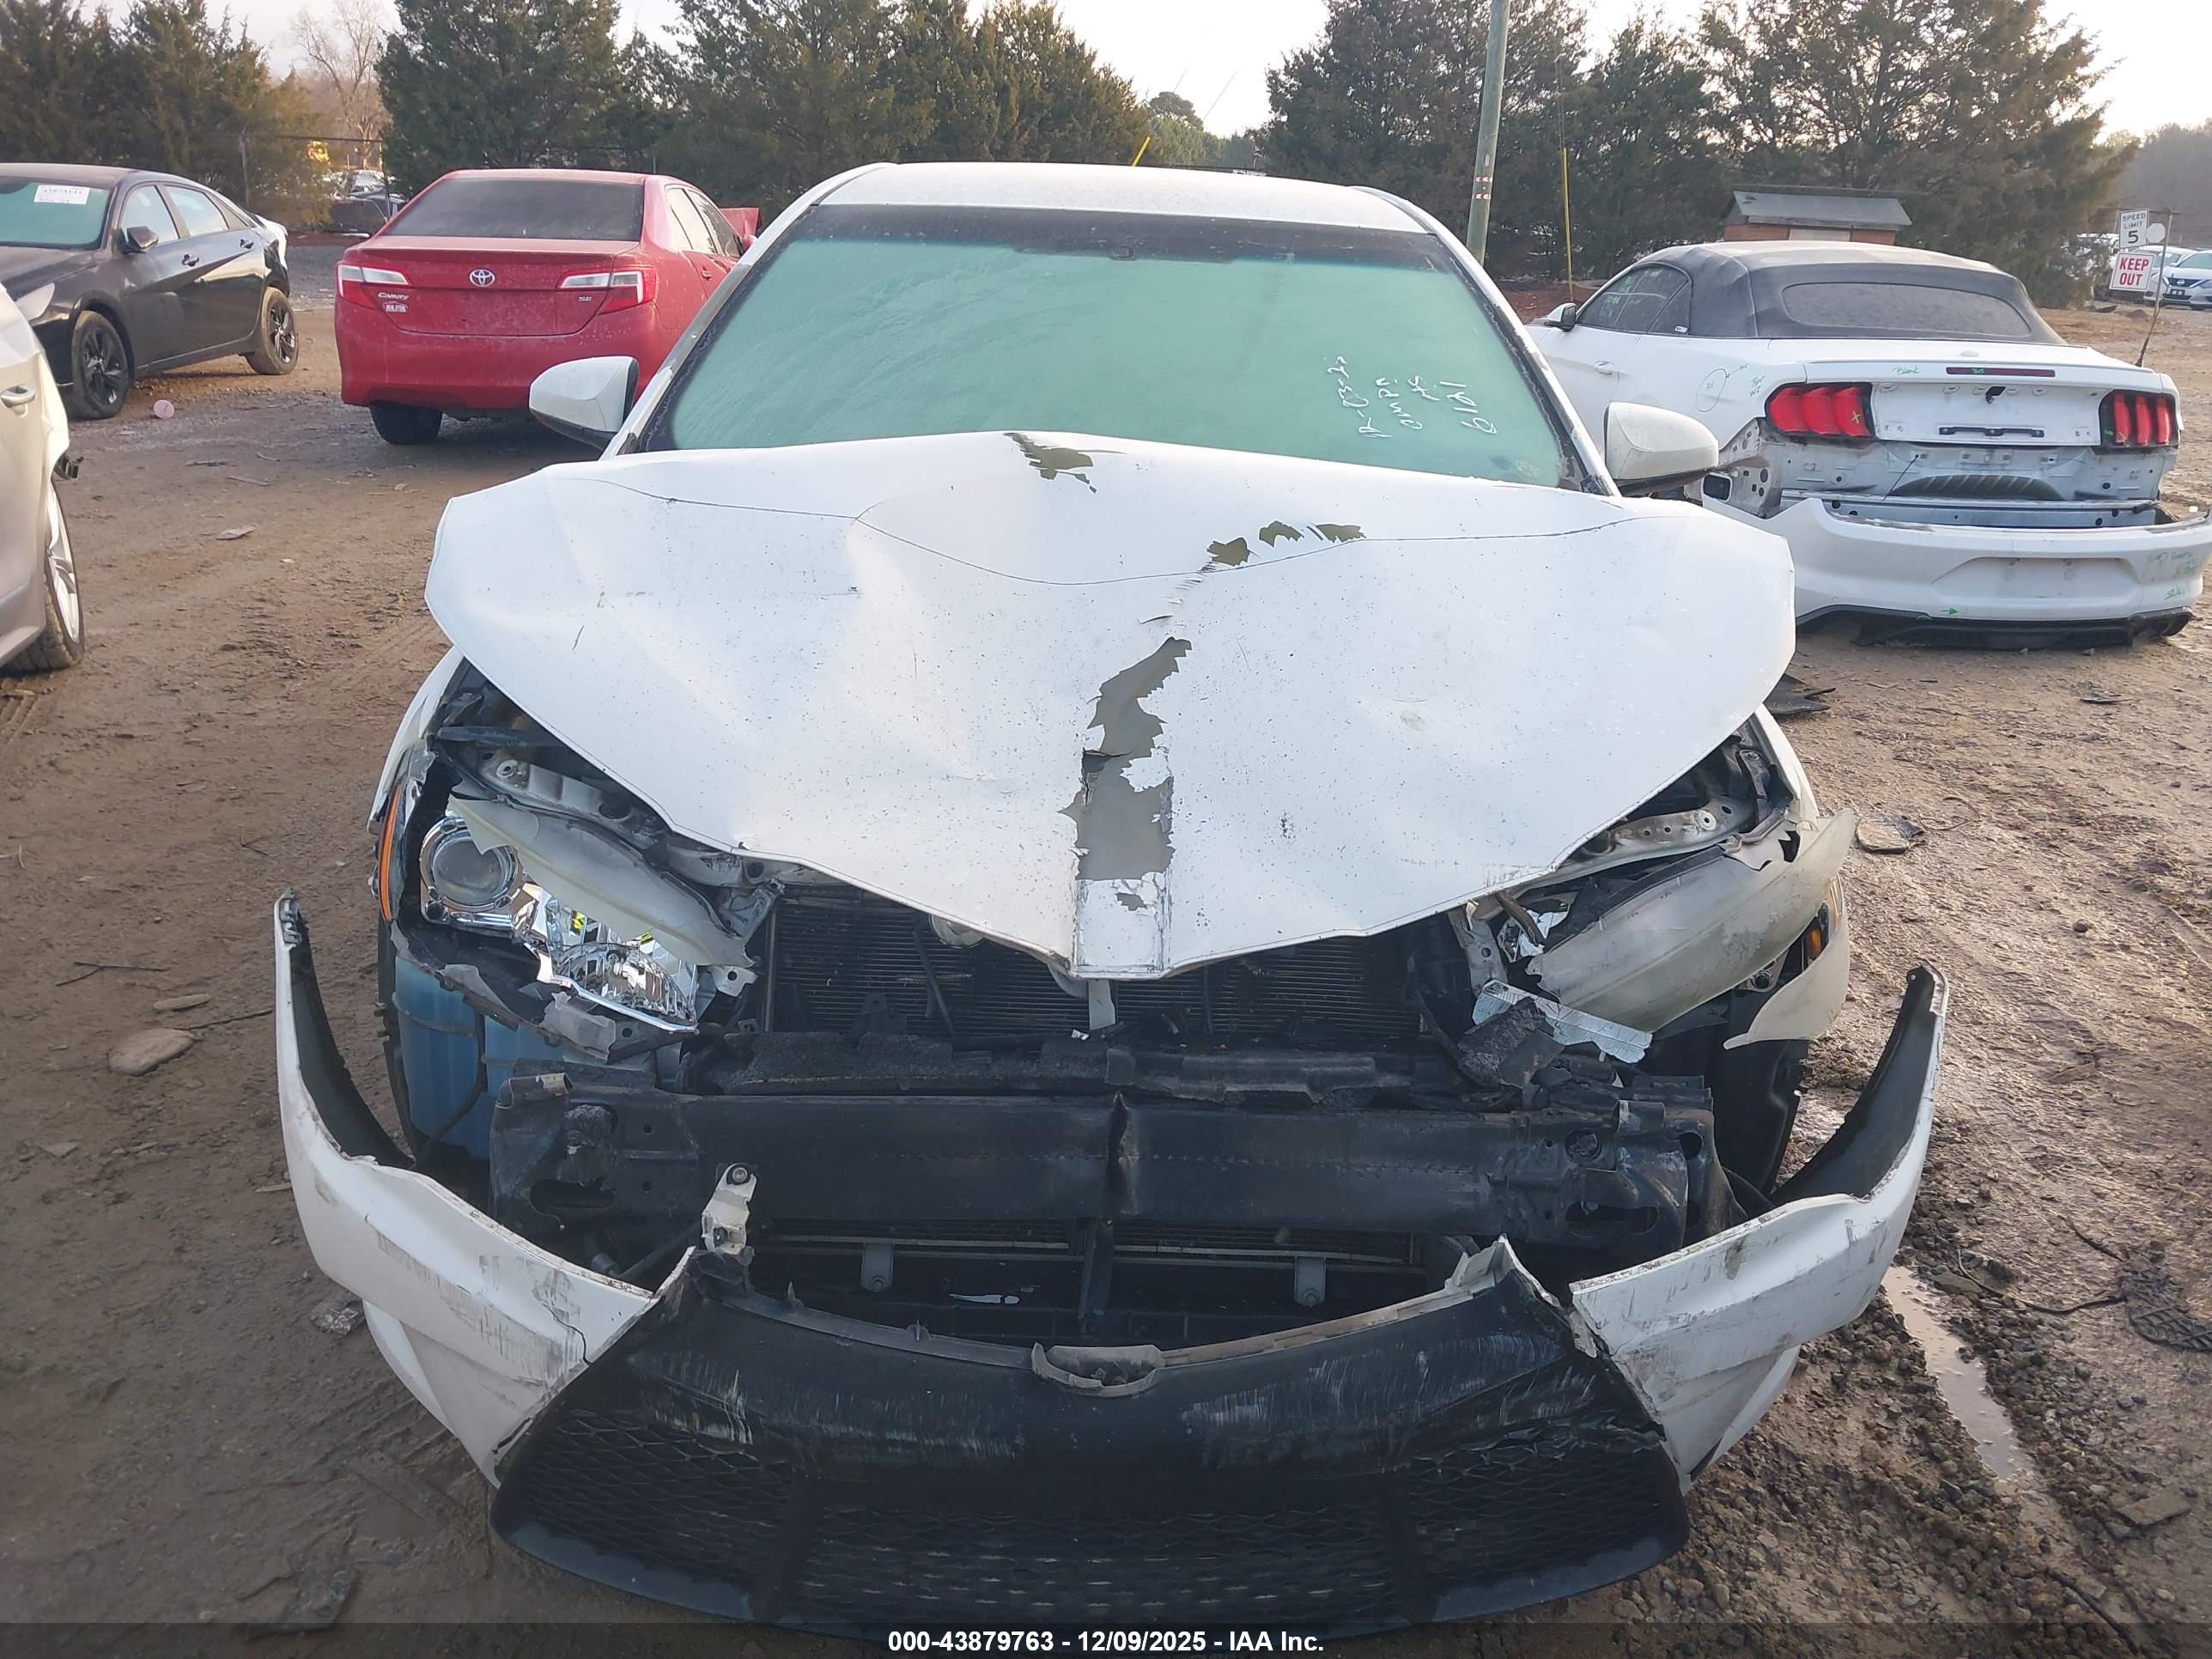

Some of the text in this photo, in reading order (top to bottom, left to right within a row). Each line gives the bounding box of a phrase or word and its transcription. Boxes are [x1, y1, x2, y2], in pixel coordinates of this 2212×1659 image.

[2128, 230, 2139, 244] 5
[2119, 258, 2149, 271] KEEP
[2119, 272, 2143, 286] OUT
